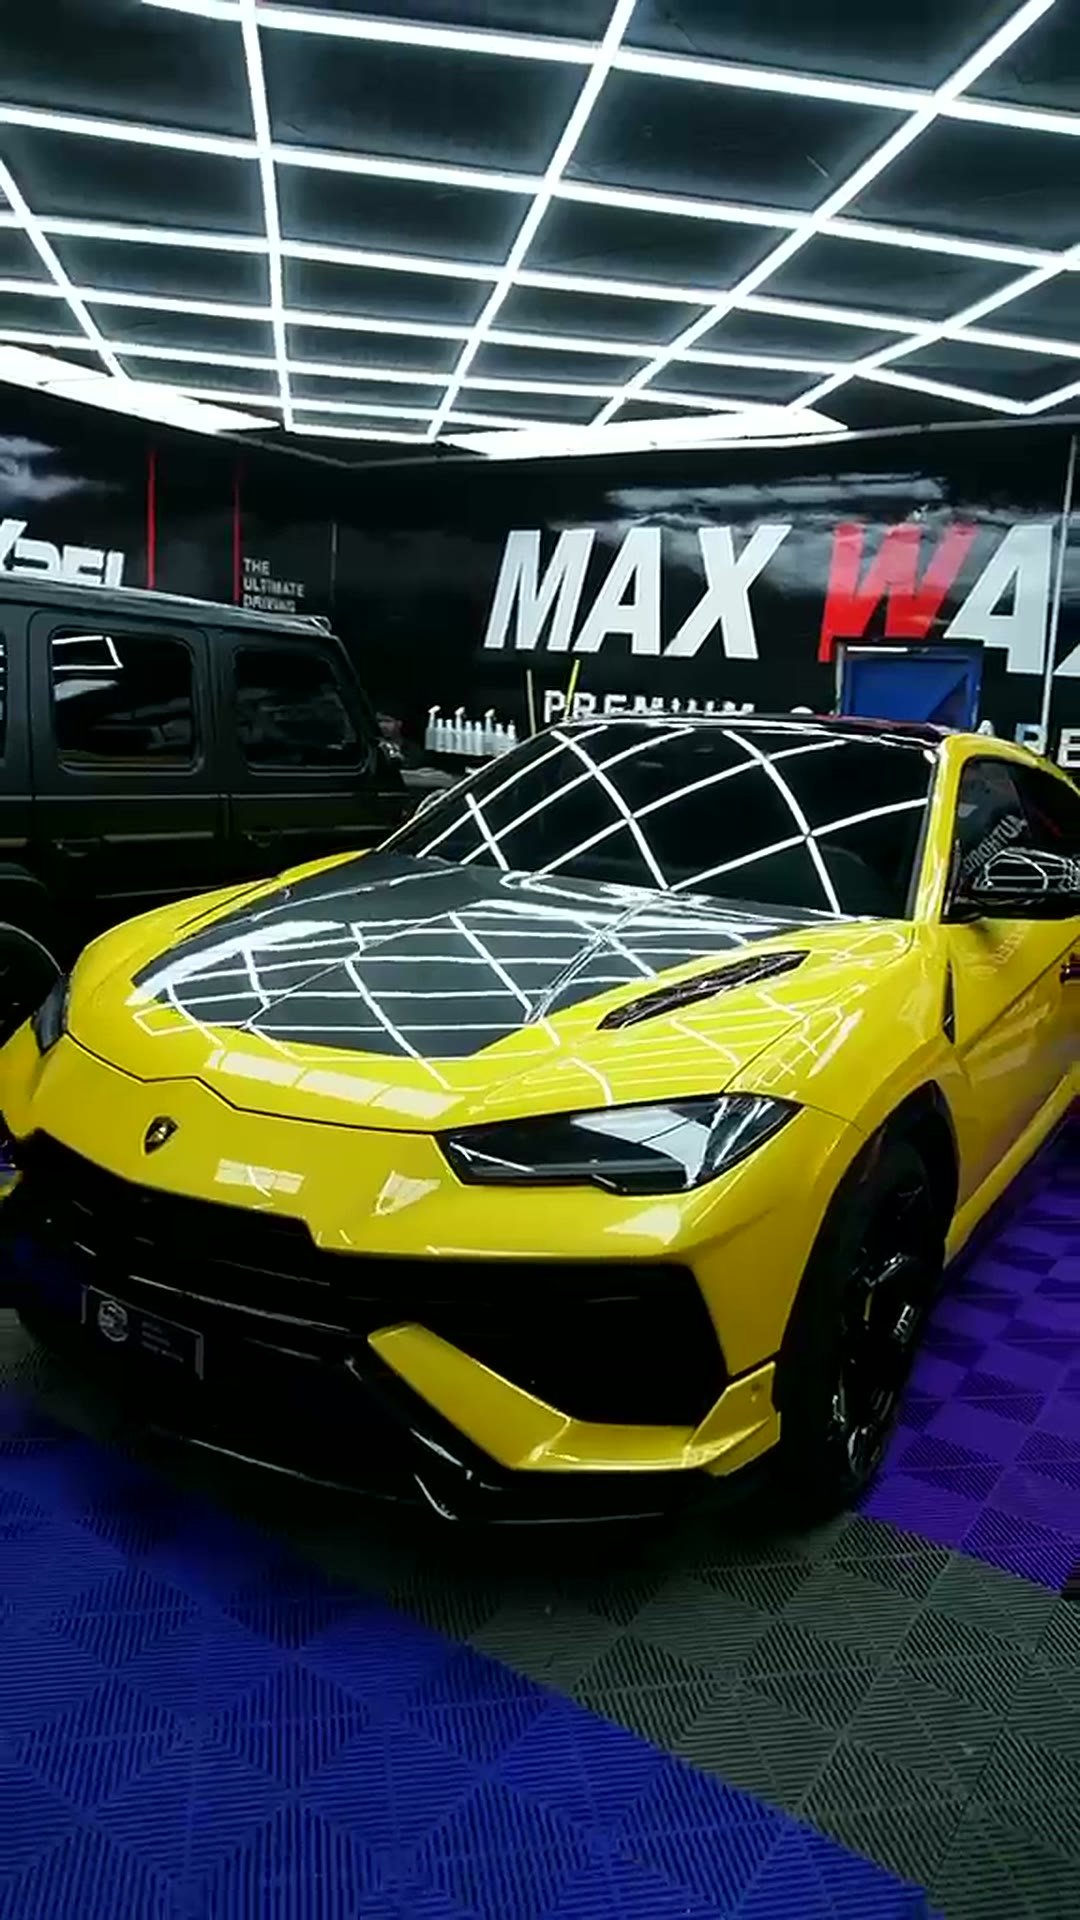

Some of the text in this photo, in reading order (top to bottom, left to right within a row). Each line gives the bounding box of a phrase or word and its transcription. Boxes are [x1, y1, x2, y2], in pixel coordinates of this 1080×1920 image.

[243, 557, 270, 576] THE
[243, 577, 305, 598] ULTIMATE
[483, 522, 1080, 677] MAX WA
